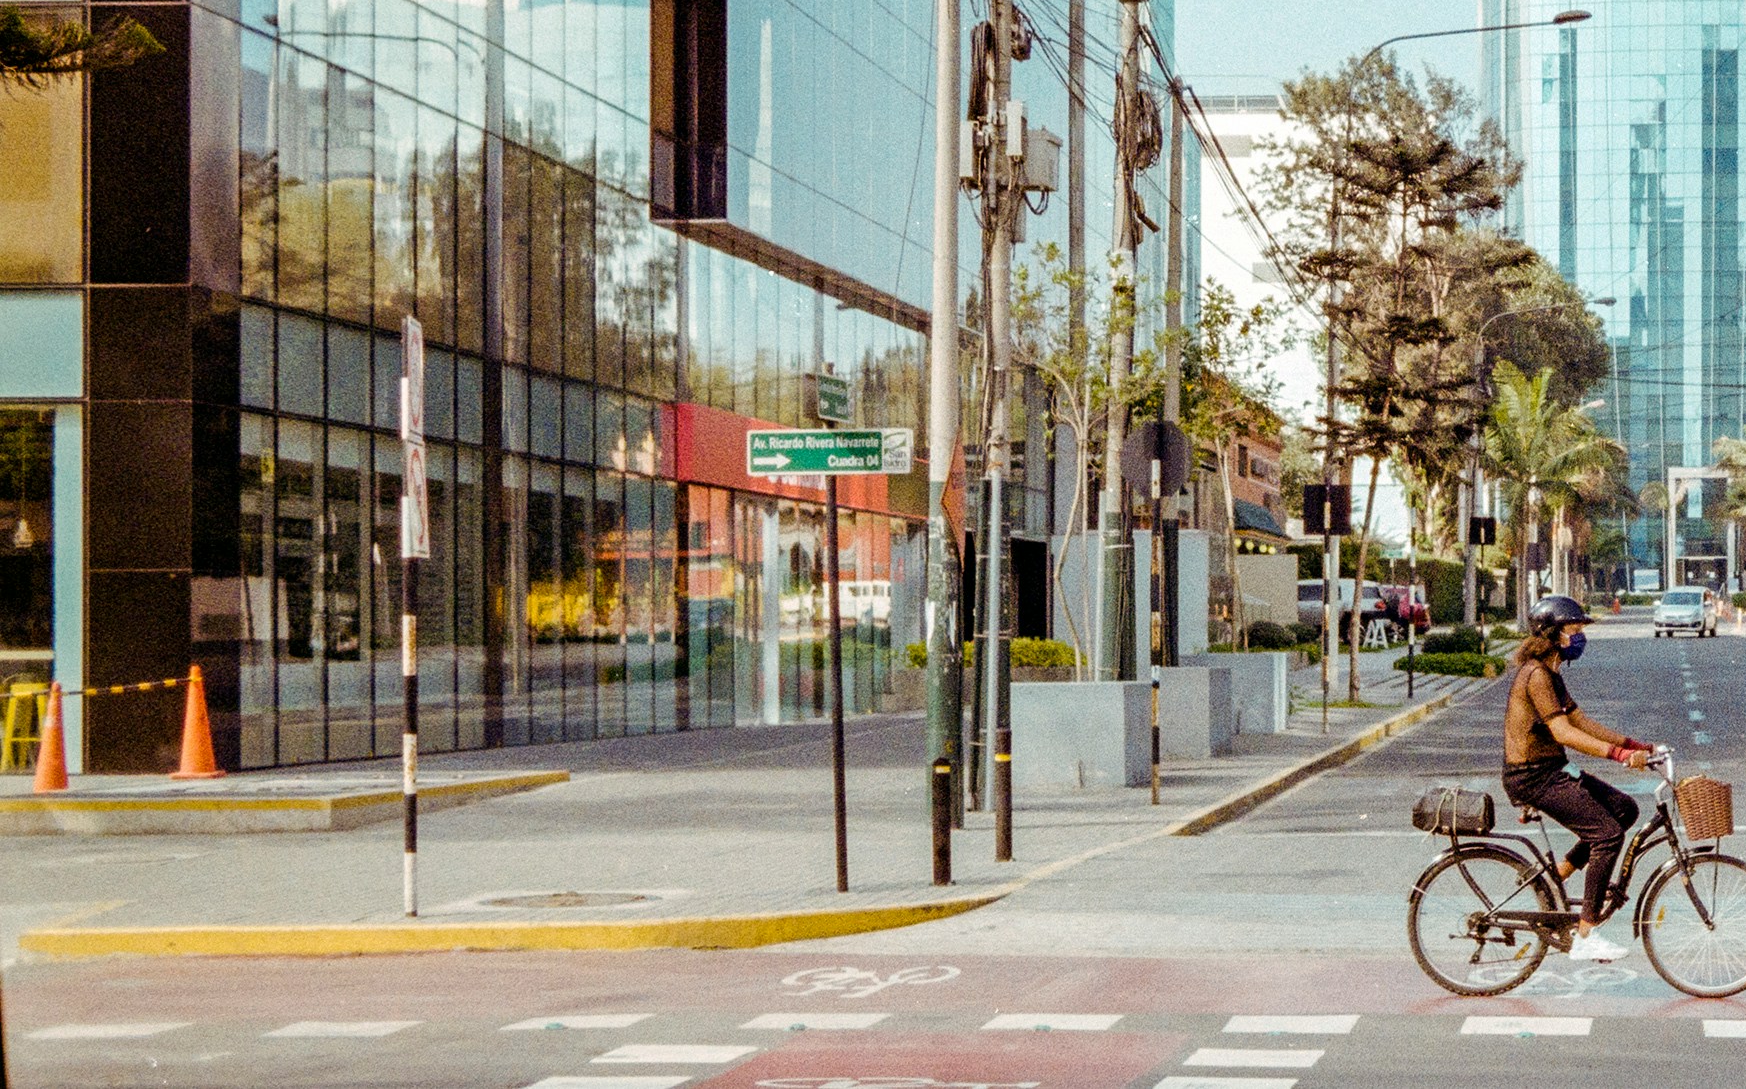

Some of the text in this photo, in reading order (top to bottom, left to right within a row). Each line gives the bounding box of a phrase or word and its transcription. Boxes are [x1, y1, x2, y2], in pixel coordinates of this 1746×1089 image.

[753, 436, 879, 449] Av. Ricardo Rivera Navarrete
[827, 455, 879, 467] Cuadra 04
